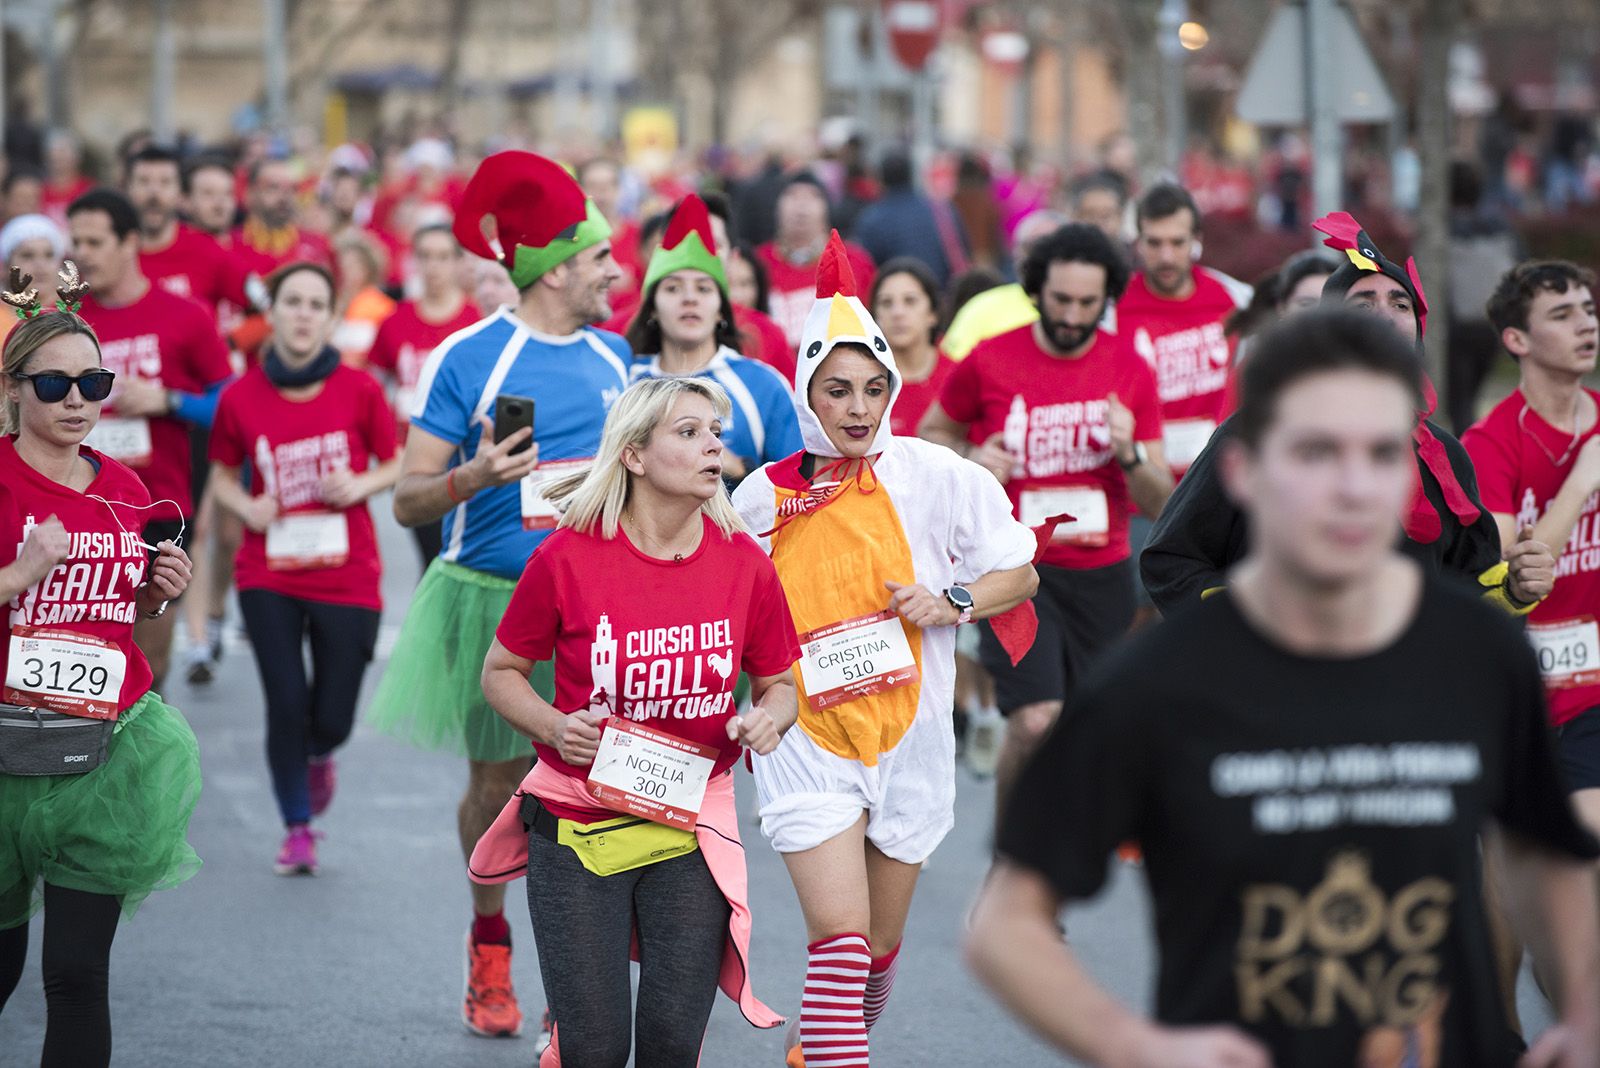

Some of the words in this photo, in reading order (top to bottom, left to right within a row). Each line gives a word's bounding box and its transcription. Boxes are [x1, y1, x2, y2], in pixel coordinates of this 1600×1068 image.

[66, 531, 115, 560] URSA
[40, 561, 122, 602] GALL
[33, 602, 88, 626] SANT
[87, 601, 137, 624] CUGA
[625, 624, 694, 659] CURSA
[700, 618, 734, 650] DEL
[817, 639, 891, 670] CRISTINA
[842, 659, 875, 681] 510
[1538, 641, 1588, 672] 049
[22, 657, 109, 696] 3129
[623, 654, 708, 700] GALL
[623, 699, 672, 723] SANT
[673, 690, 733, 720] CUGAT
[64, 754, 89, 763] SPORT
[625, 754, 685, 785] NOELIA
[632, 776, 667, 799] 300
[1238, 874, 1453, 962] DOG
